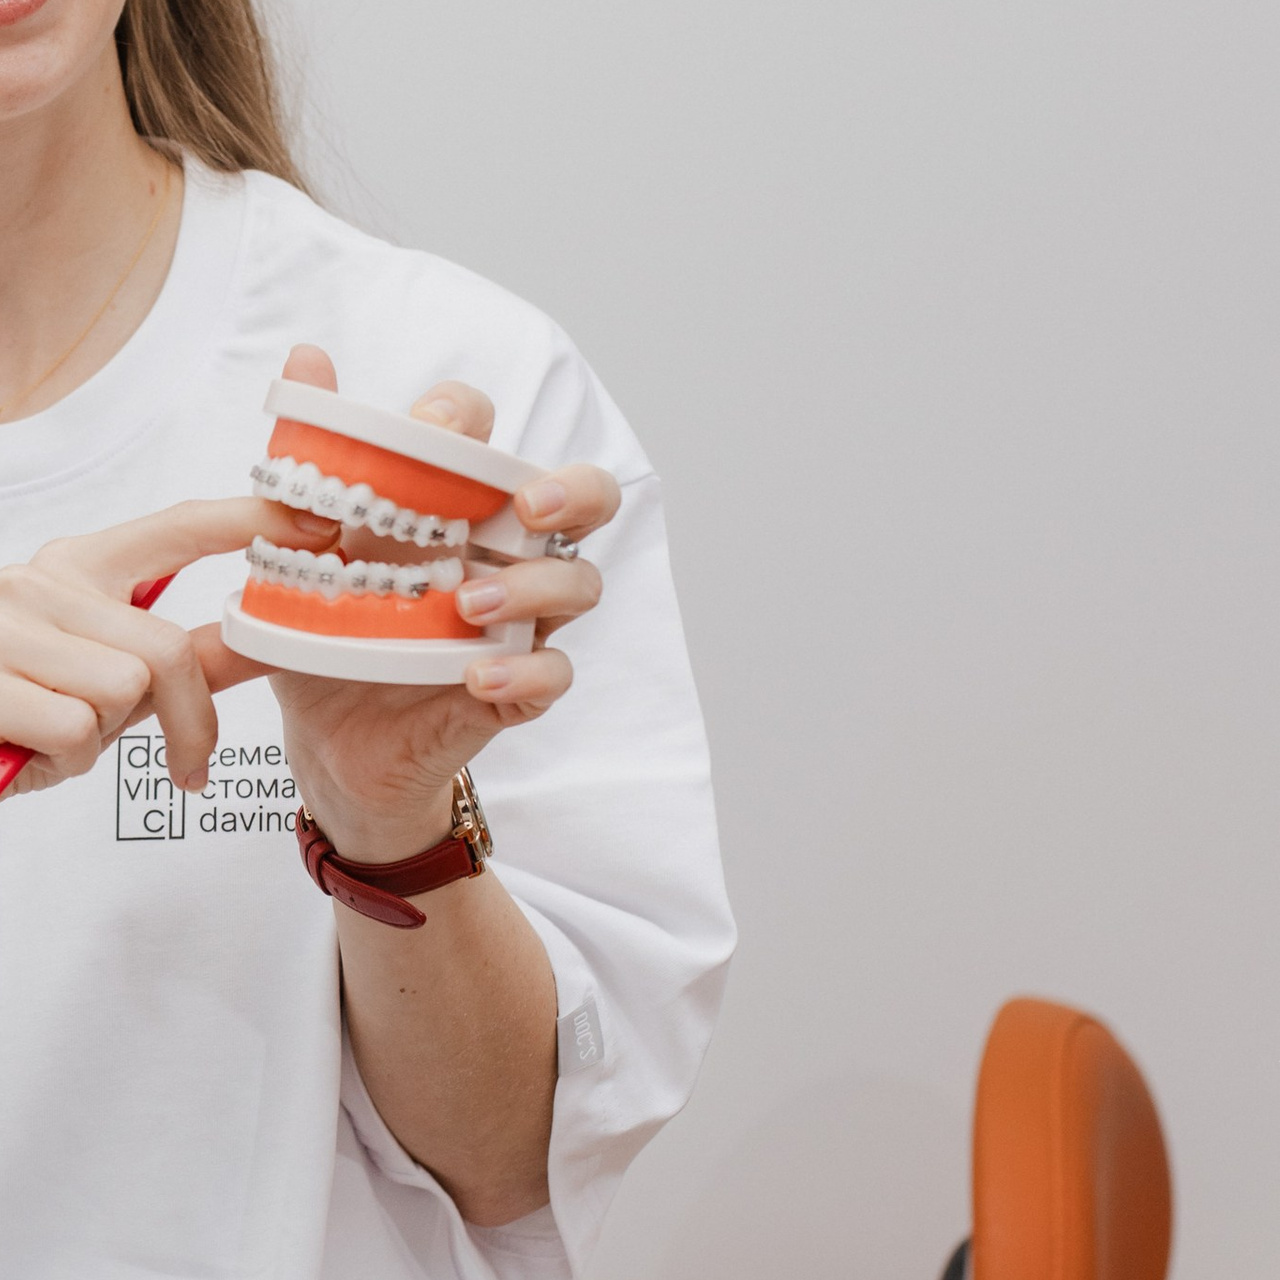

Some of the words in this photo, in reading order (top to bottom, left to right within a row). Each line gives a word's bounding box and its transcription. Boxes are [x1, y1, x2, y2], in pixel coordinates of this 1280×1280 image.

[124, 771, 174, 801] vin
[200, 777, 296, 799] стома
[143, 802, 174, 839] ci
[199, 805, 297, 832] davinc
